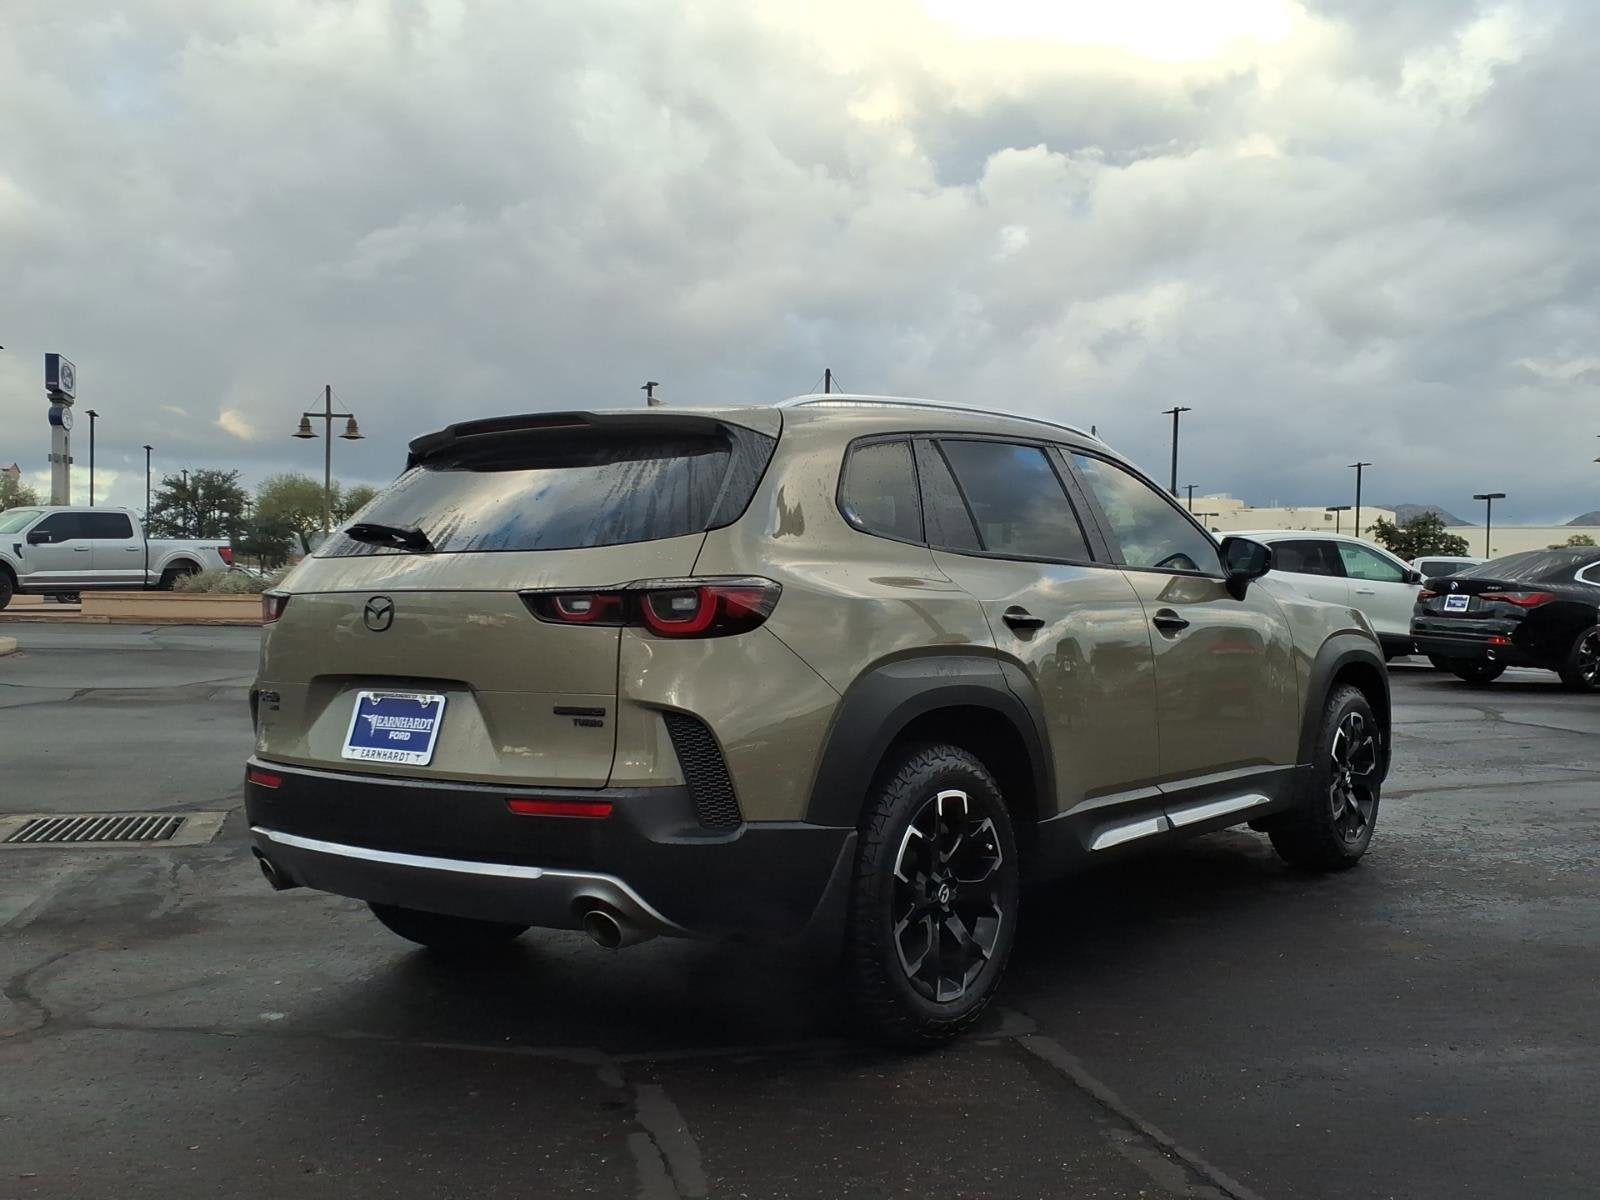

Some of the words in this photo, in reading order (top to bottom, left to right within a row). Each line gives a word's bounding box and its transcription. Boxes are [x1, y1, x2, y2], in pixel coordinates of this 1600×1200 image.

[376, 716, 434, 730] EARNHARDT
[388, 731, 411, 740] FORD
[360, 749, 410, 762] EARNHARDT
